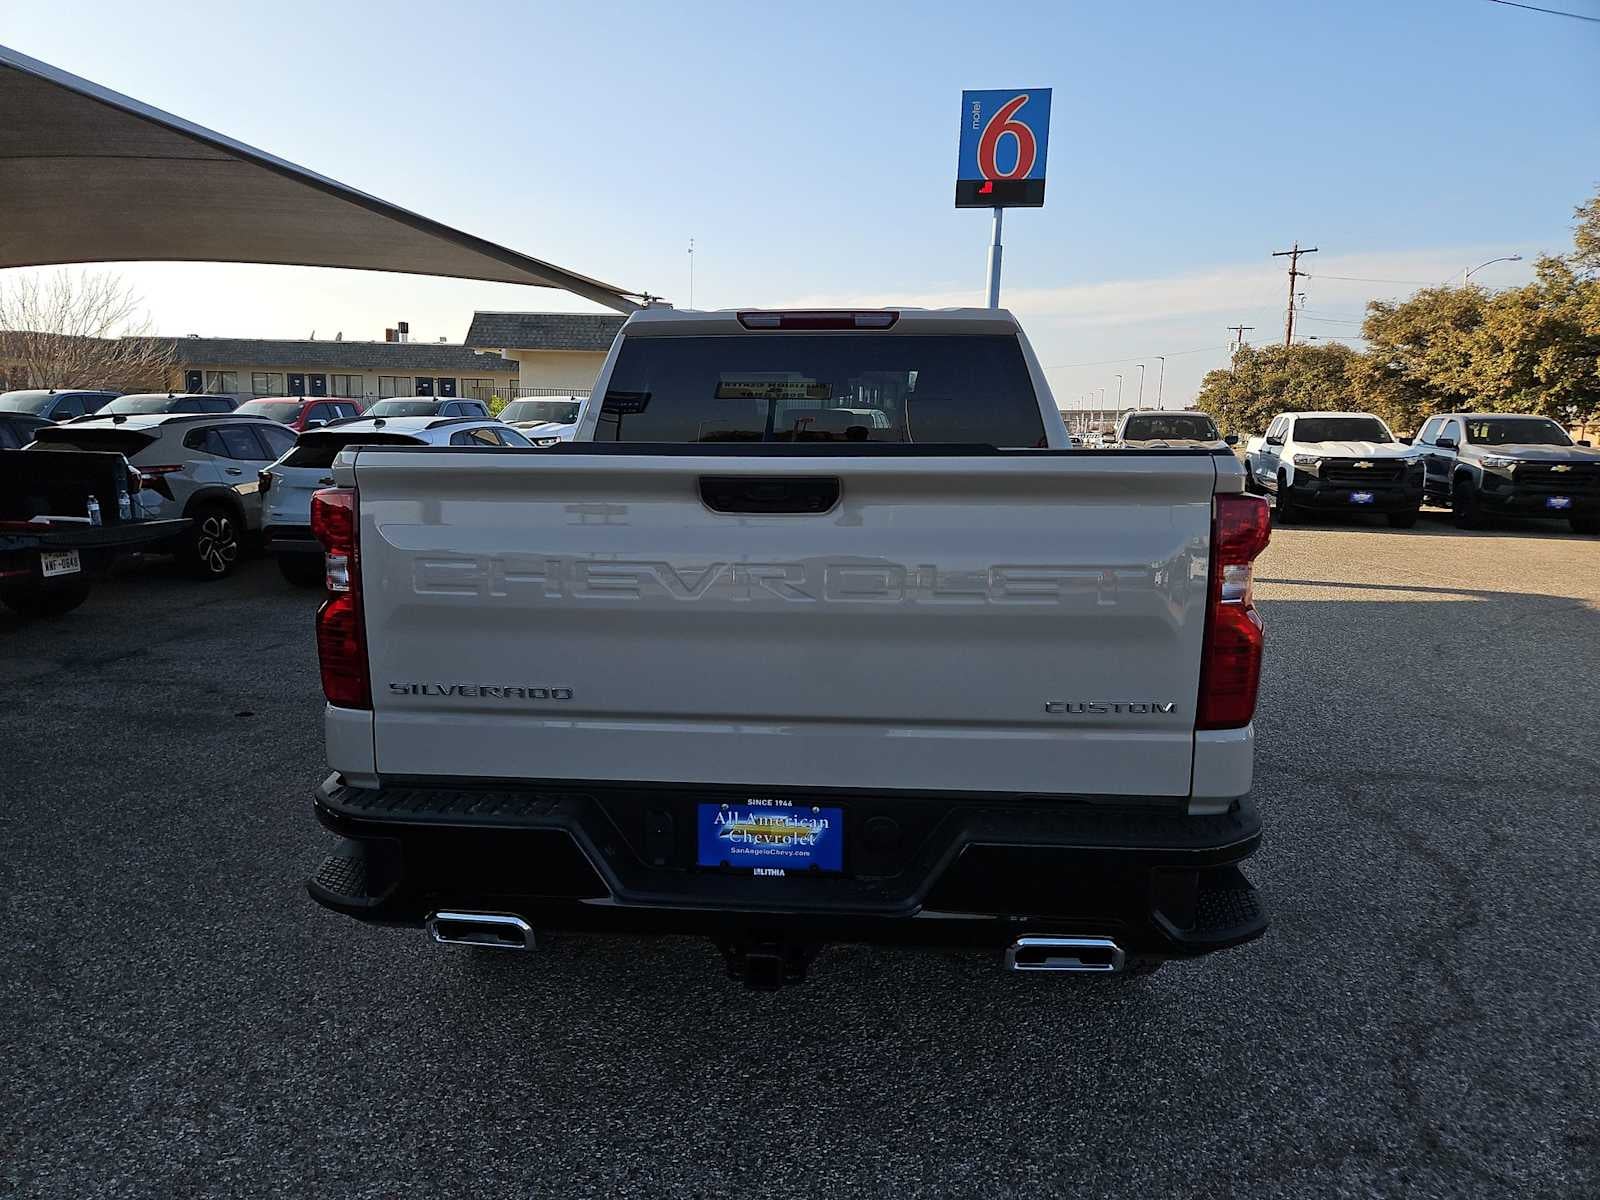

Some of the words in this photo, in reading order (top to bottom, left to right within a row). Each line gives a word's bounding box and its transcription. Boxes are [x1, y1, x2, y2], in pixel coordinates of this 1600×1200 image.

[972, 101, 980, 129] motel
[977, 94, 1037, 180] 6
[413, 556, 1148, 604] CHEVROLET
[389, 682, 575, 701] SILVERADO
[1045, 701, 1177, 715] CUSTOM
[714, 811, 738, 825] All
[745, 812, 829, 829] American
[729, 829, 815, 846] Chevrolet
[730, 847, 810, 856] SanAngeloChevy.com
